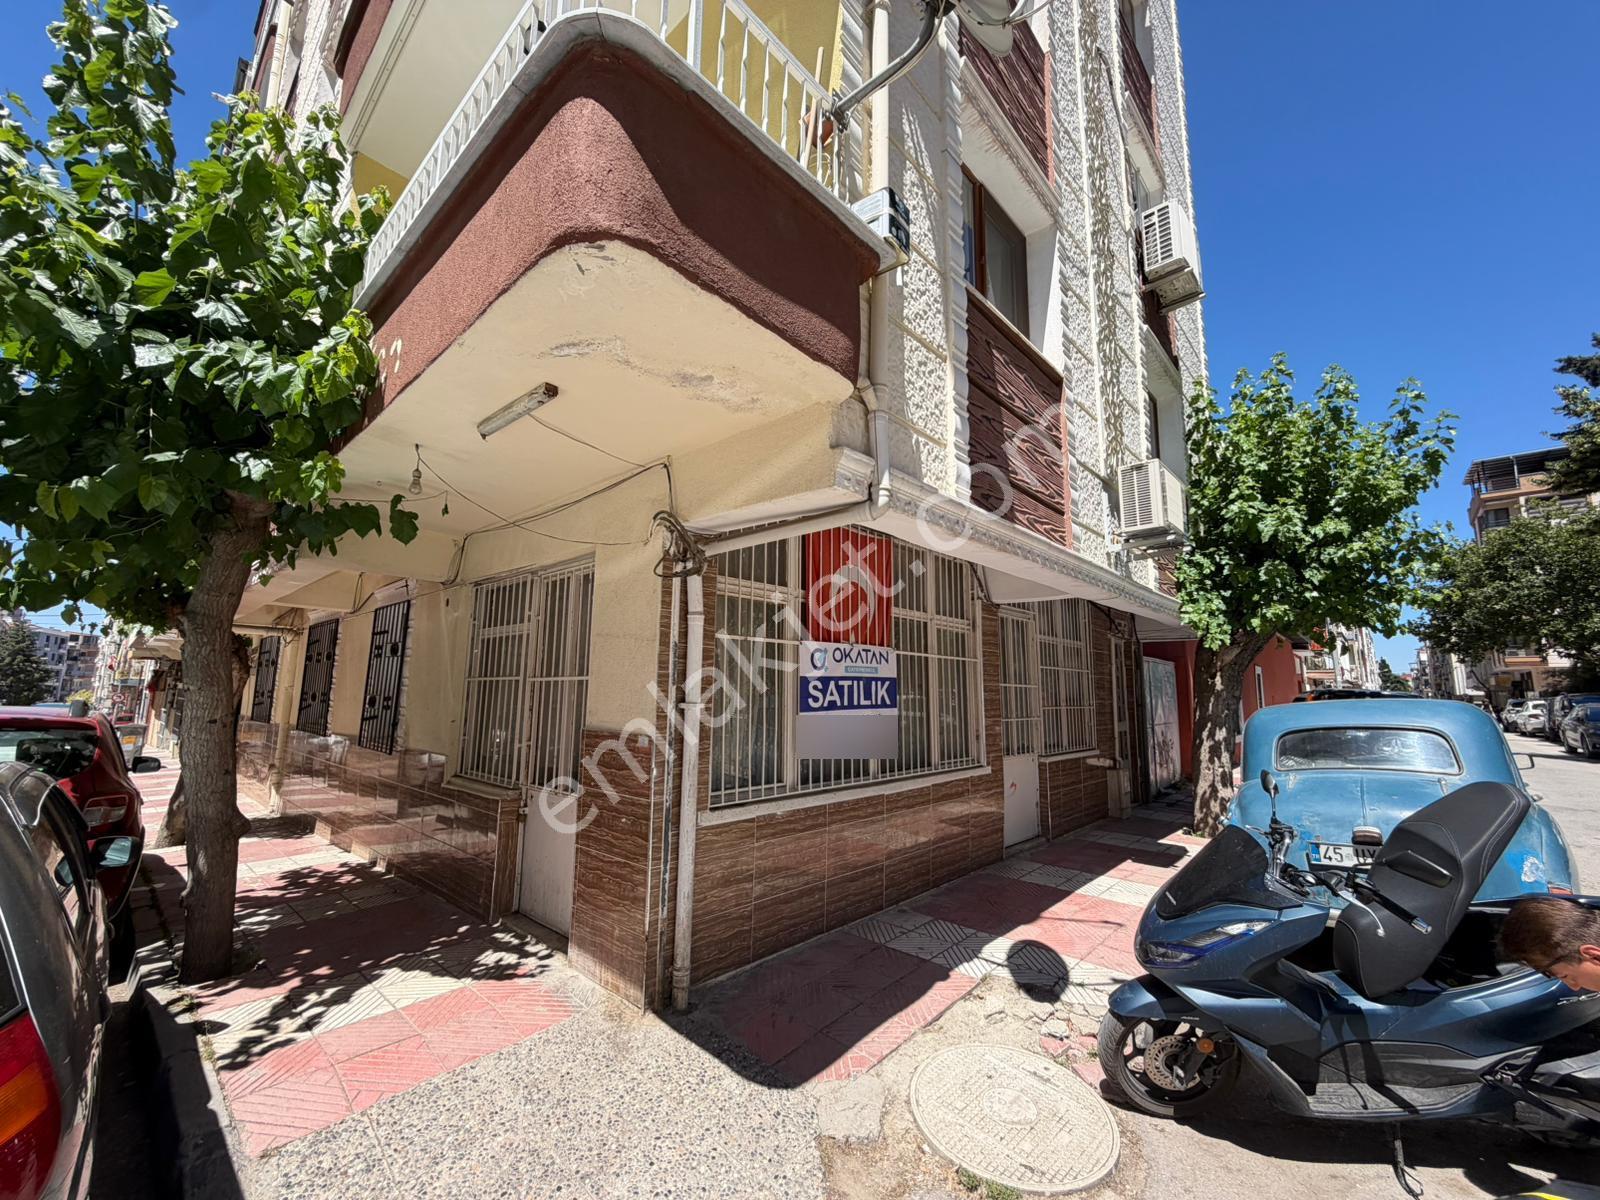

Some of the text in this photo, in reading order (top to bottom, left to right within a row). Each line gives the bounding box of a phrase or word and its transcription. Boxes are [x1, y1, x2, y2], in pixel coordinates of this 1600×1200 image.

[832, 647, 889, 665] OKATAN
[807, 680, 891, 708] SATILIK
[1323, 846, 1344, 862] 45
